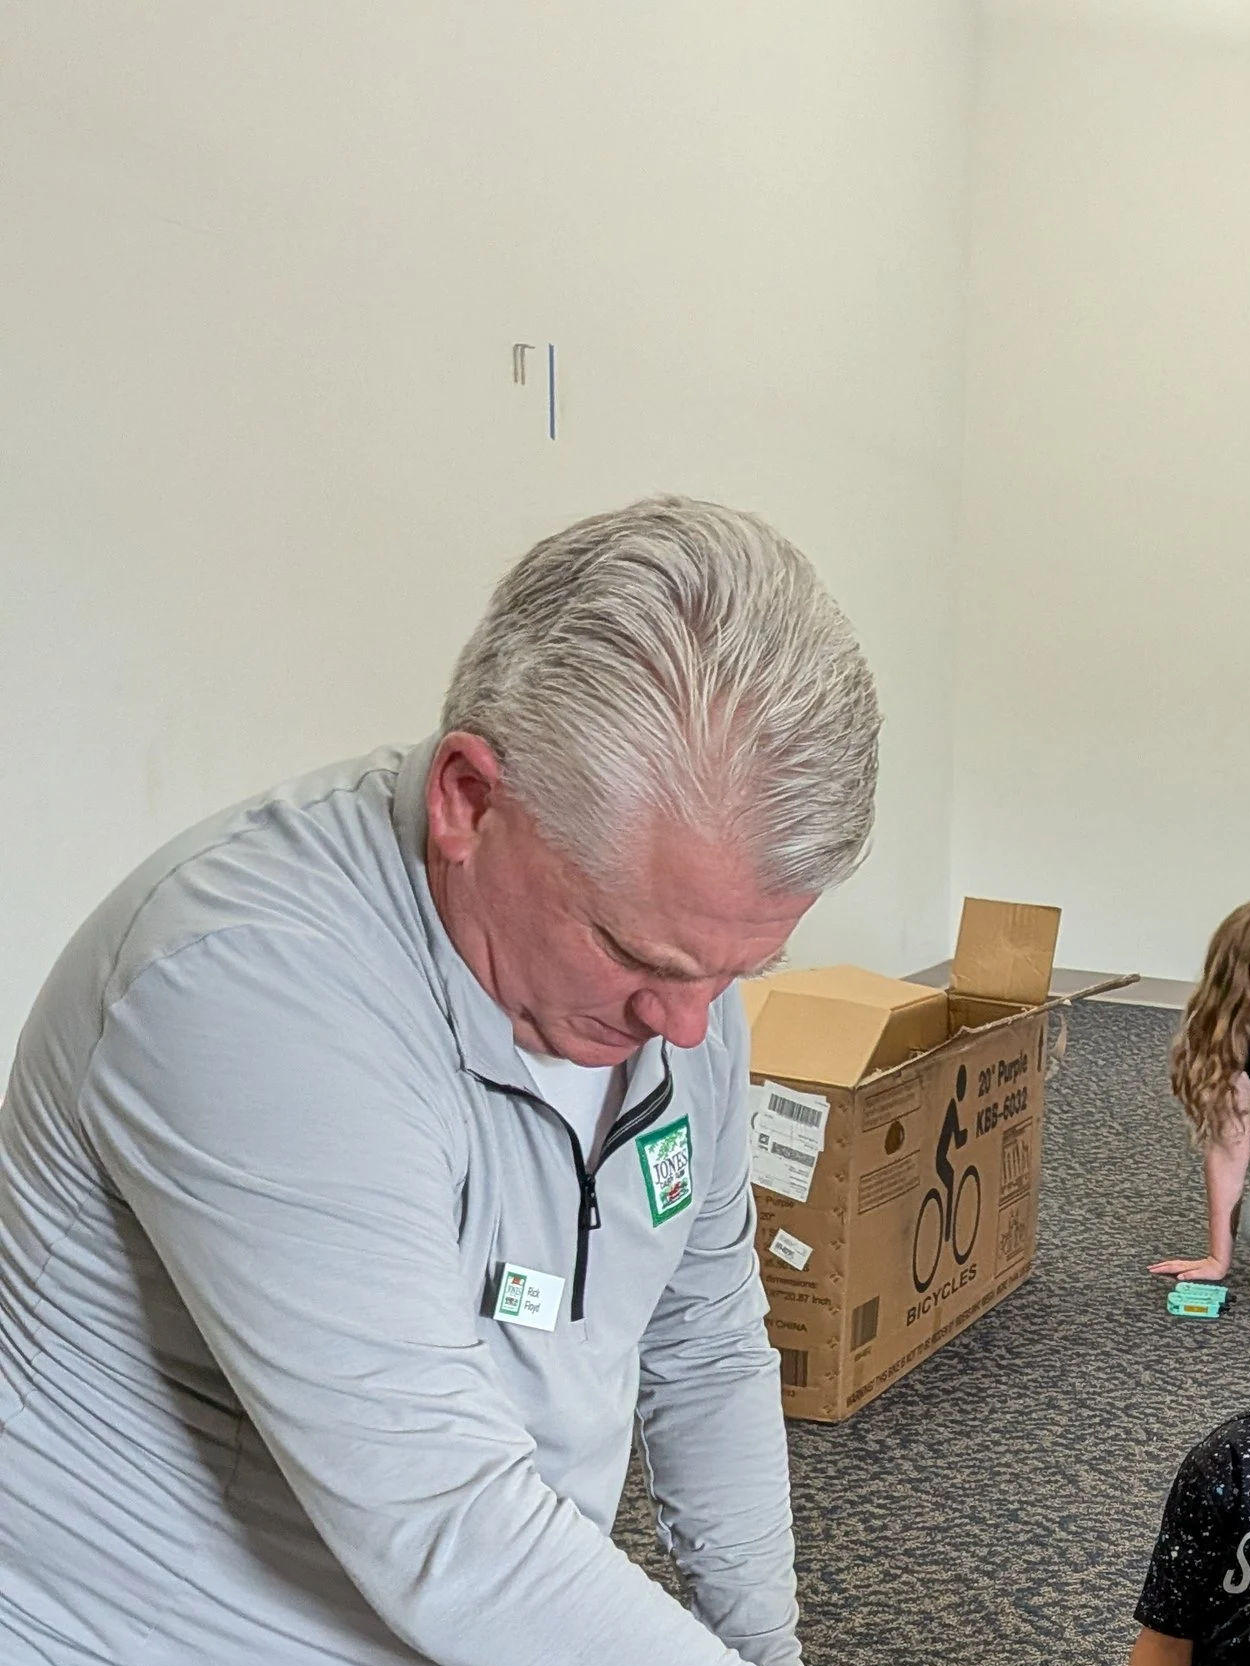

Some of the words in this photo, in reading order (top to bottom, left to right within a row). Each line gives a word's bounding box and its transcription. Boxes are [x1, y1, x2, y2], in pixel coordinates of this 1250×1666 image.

[998, 1049, 1028, 1087] Purple
[653, 1149, 688, 1185] JONES
[906, 1263, 977, 1327] BICYCLES
